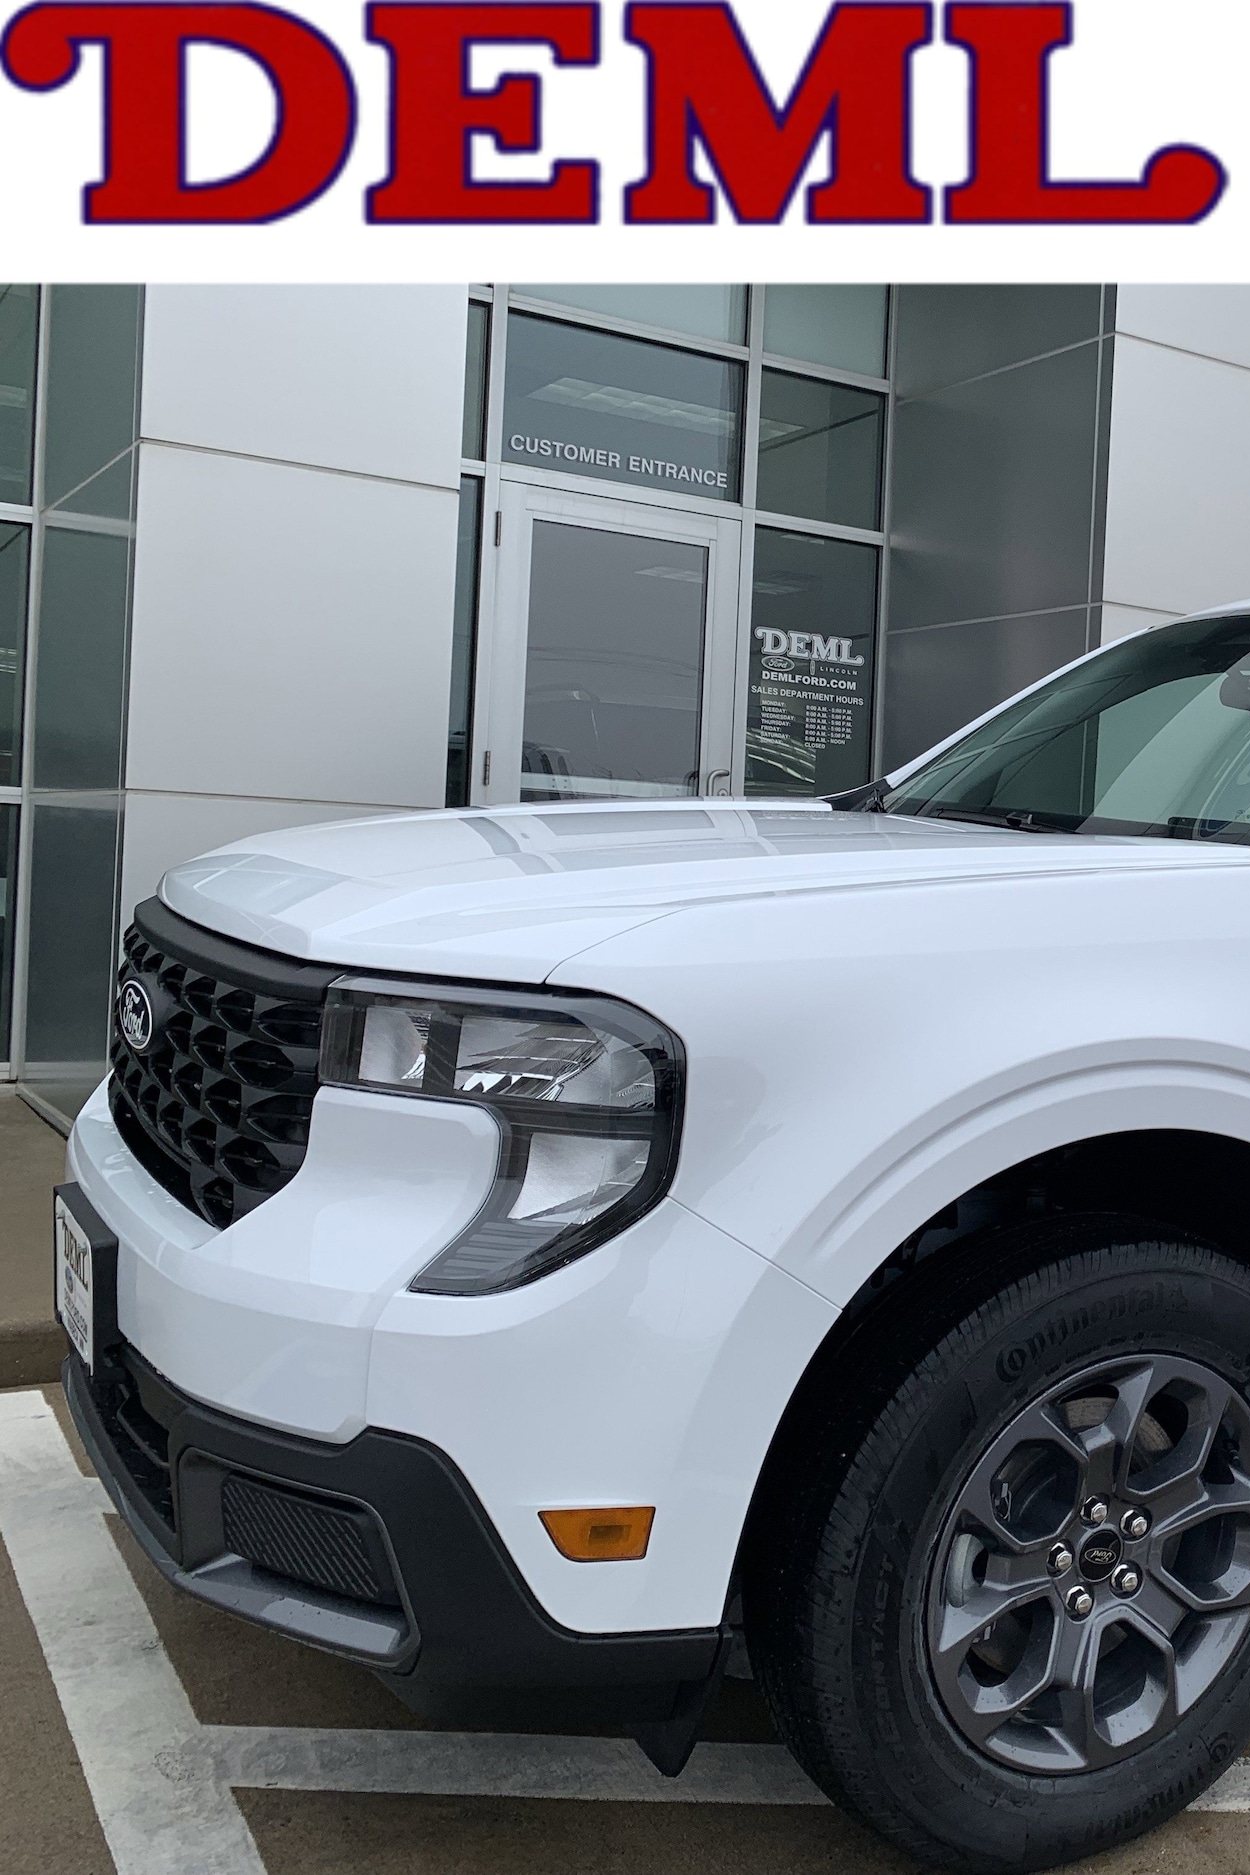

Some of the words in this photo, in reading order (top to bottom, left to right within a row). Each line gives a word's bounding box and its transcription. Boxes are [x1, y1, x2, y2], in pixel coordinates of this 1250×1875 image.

[510, 434, 620, 468] CUSTOMER
[629, 455, 728, 488] ENTRANCE
[754, 626, 864, 666] DEML
[762, 670, 857, 691] DEMLFORD.COM
[820, 666, 858, 676] LINCOLN
[751, 685, 778, 696] SALES
[780, 688, 835, 703] DEPARTMENT
[835, 694, 864, 706] HOURS
[123, 987, 145, 1040] Ford
[995, 1281, 1163, 1384] Continental
